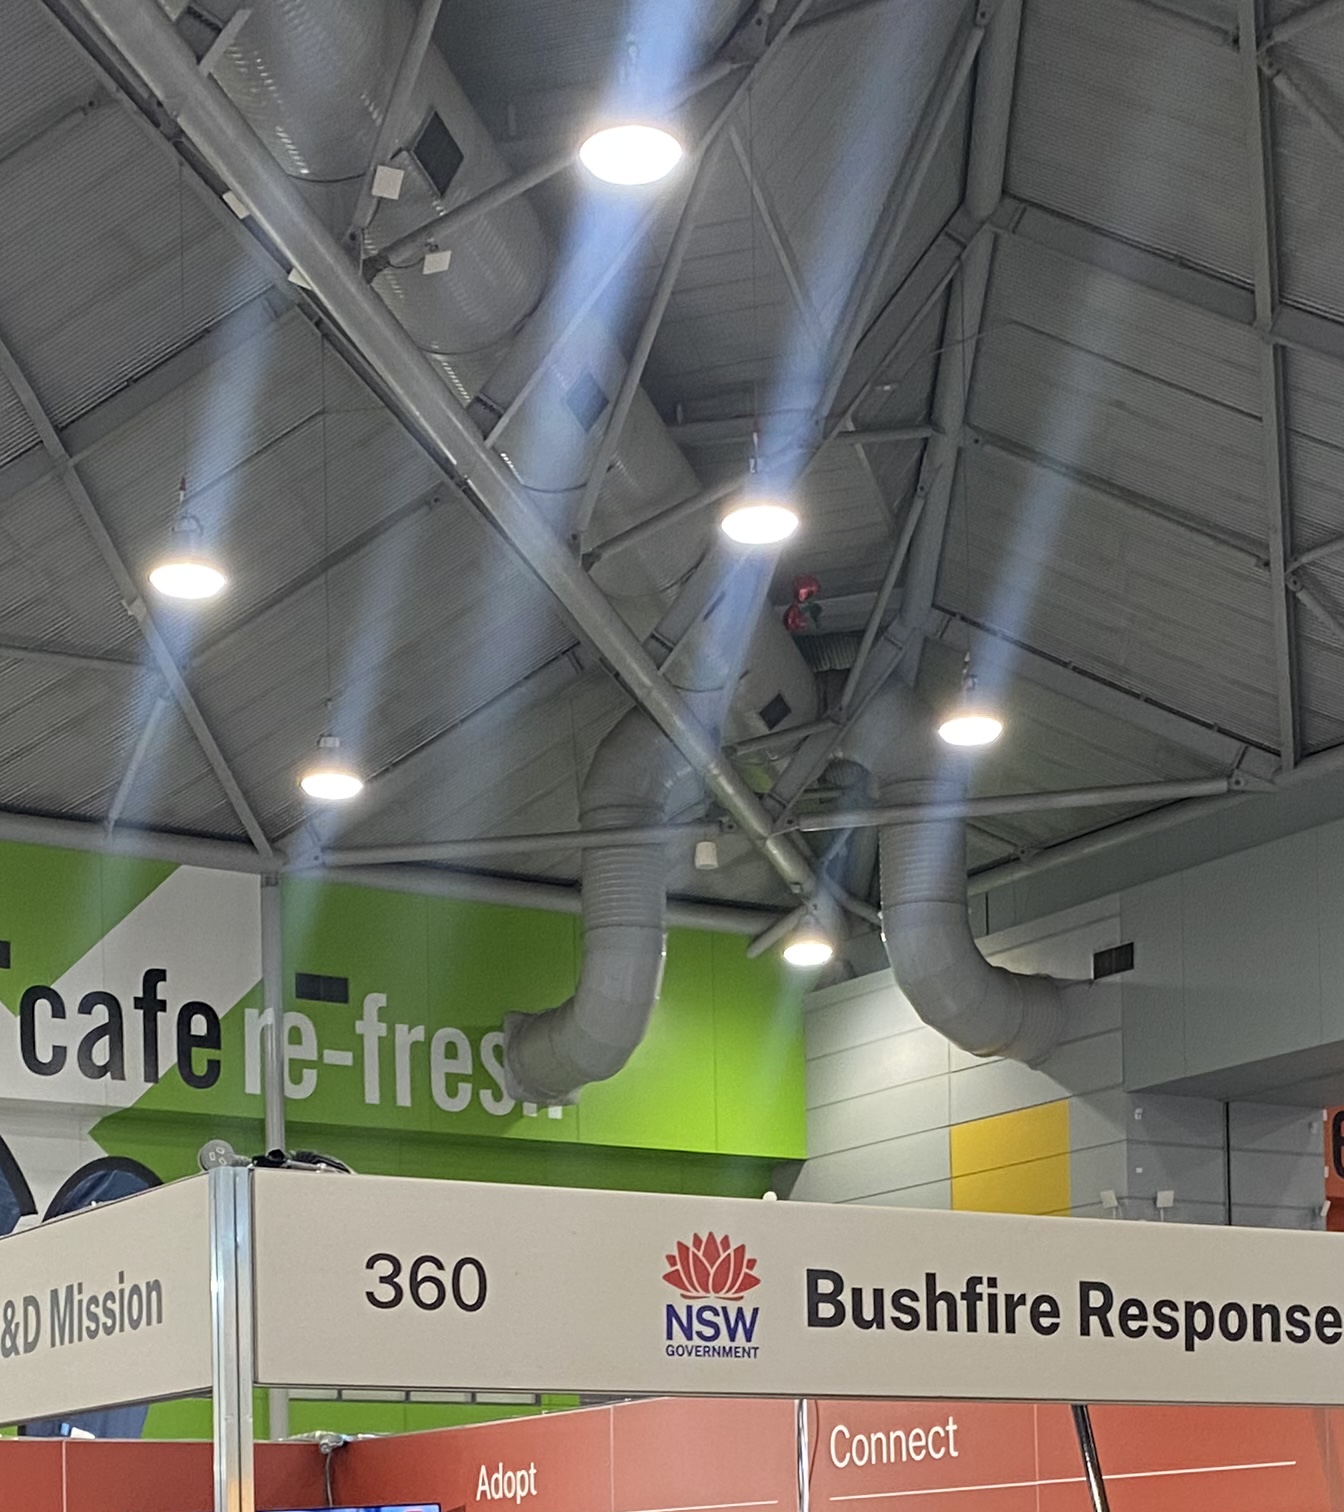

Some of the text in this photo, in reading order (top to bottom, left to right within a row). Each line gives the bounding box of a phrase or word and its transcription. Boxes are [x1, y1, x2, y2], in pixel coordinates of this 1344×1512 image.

[18, 968, 564, 1119] cafe re-fres
[49, 1270, 164, 1349] Mission
[364, 1252, 488, 1313] 360
[805, 1268, 1060, 1338] Bushfire
[1078, 1280, 1344, 1352] Response
[665, 1303, 760, 1343] NSW
[665, 1344, 760, 1359] GOVERNMENT
[829, 1416, 959, 1468] Connect
[475, 1461, 538, 1504] Adopt
